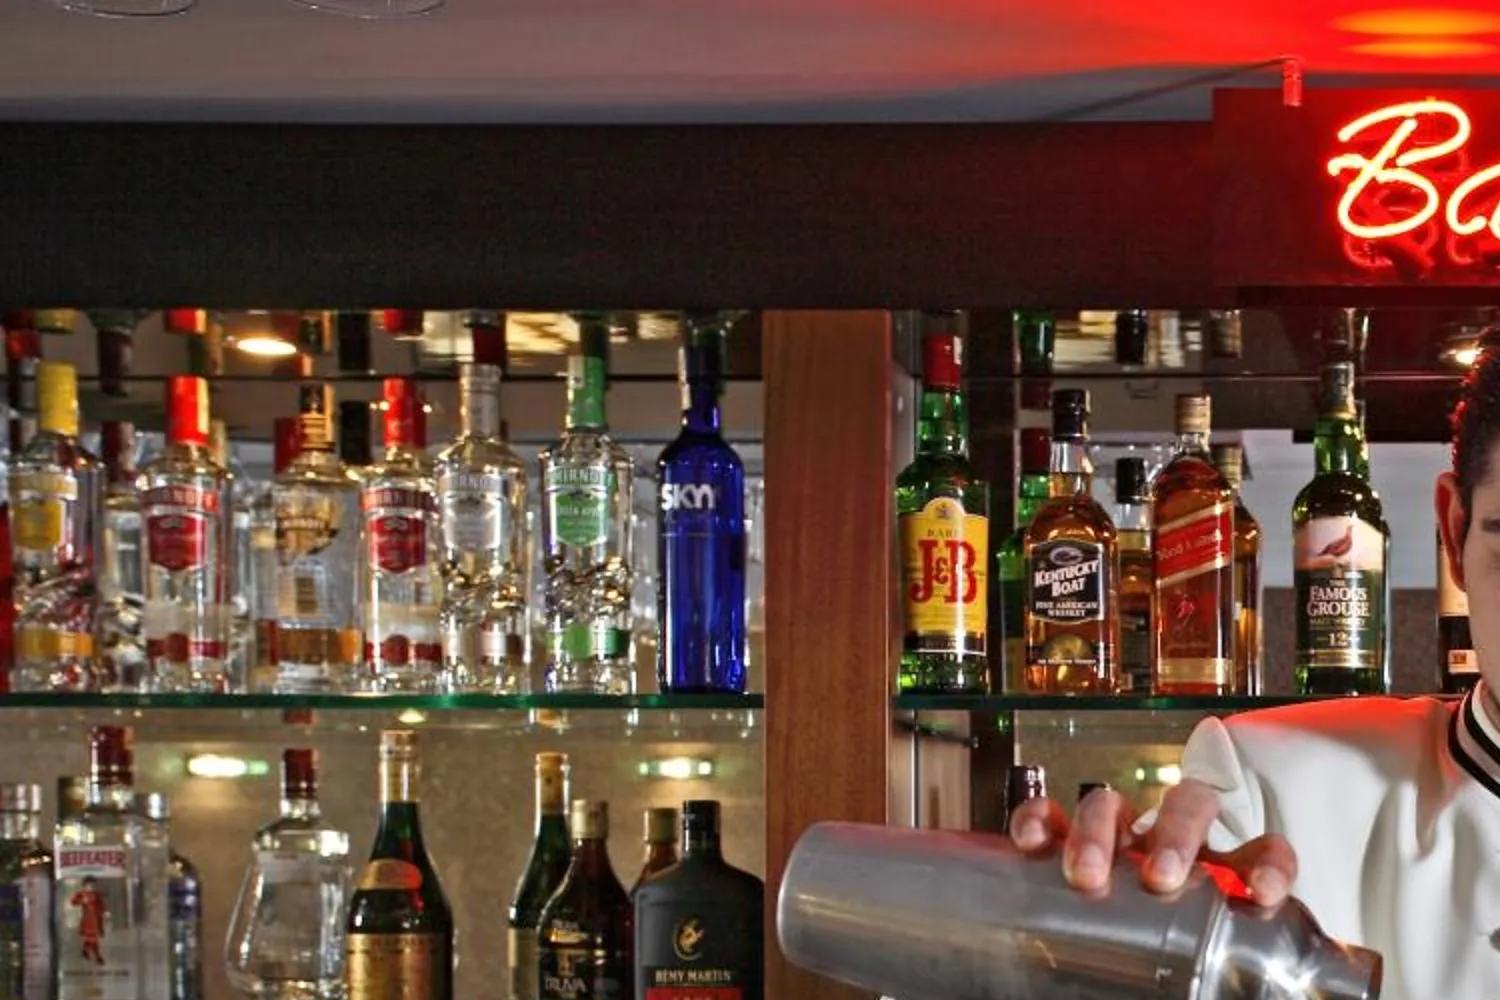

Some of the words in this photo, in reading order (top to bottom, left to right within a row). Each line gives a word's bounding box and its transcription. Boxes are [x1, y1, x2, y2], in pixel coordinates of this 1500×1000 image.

[910, 539, 978, 604] J&B
[1034, 560, 1099, 588] KENTUCKY
[1051, 577, 1087, 598] BOAT
[1309, 587, 1368, 601] FAMOUS
[1056, 601, 1098, 610] AMERICAN
[1306, 601, 1371, 617] GROUSE
[1328, 631, 1348, 647] 12
[58, 849, 127, 869] BEEFEATER
[687, 969, 731, 983] MARTIN
